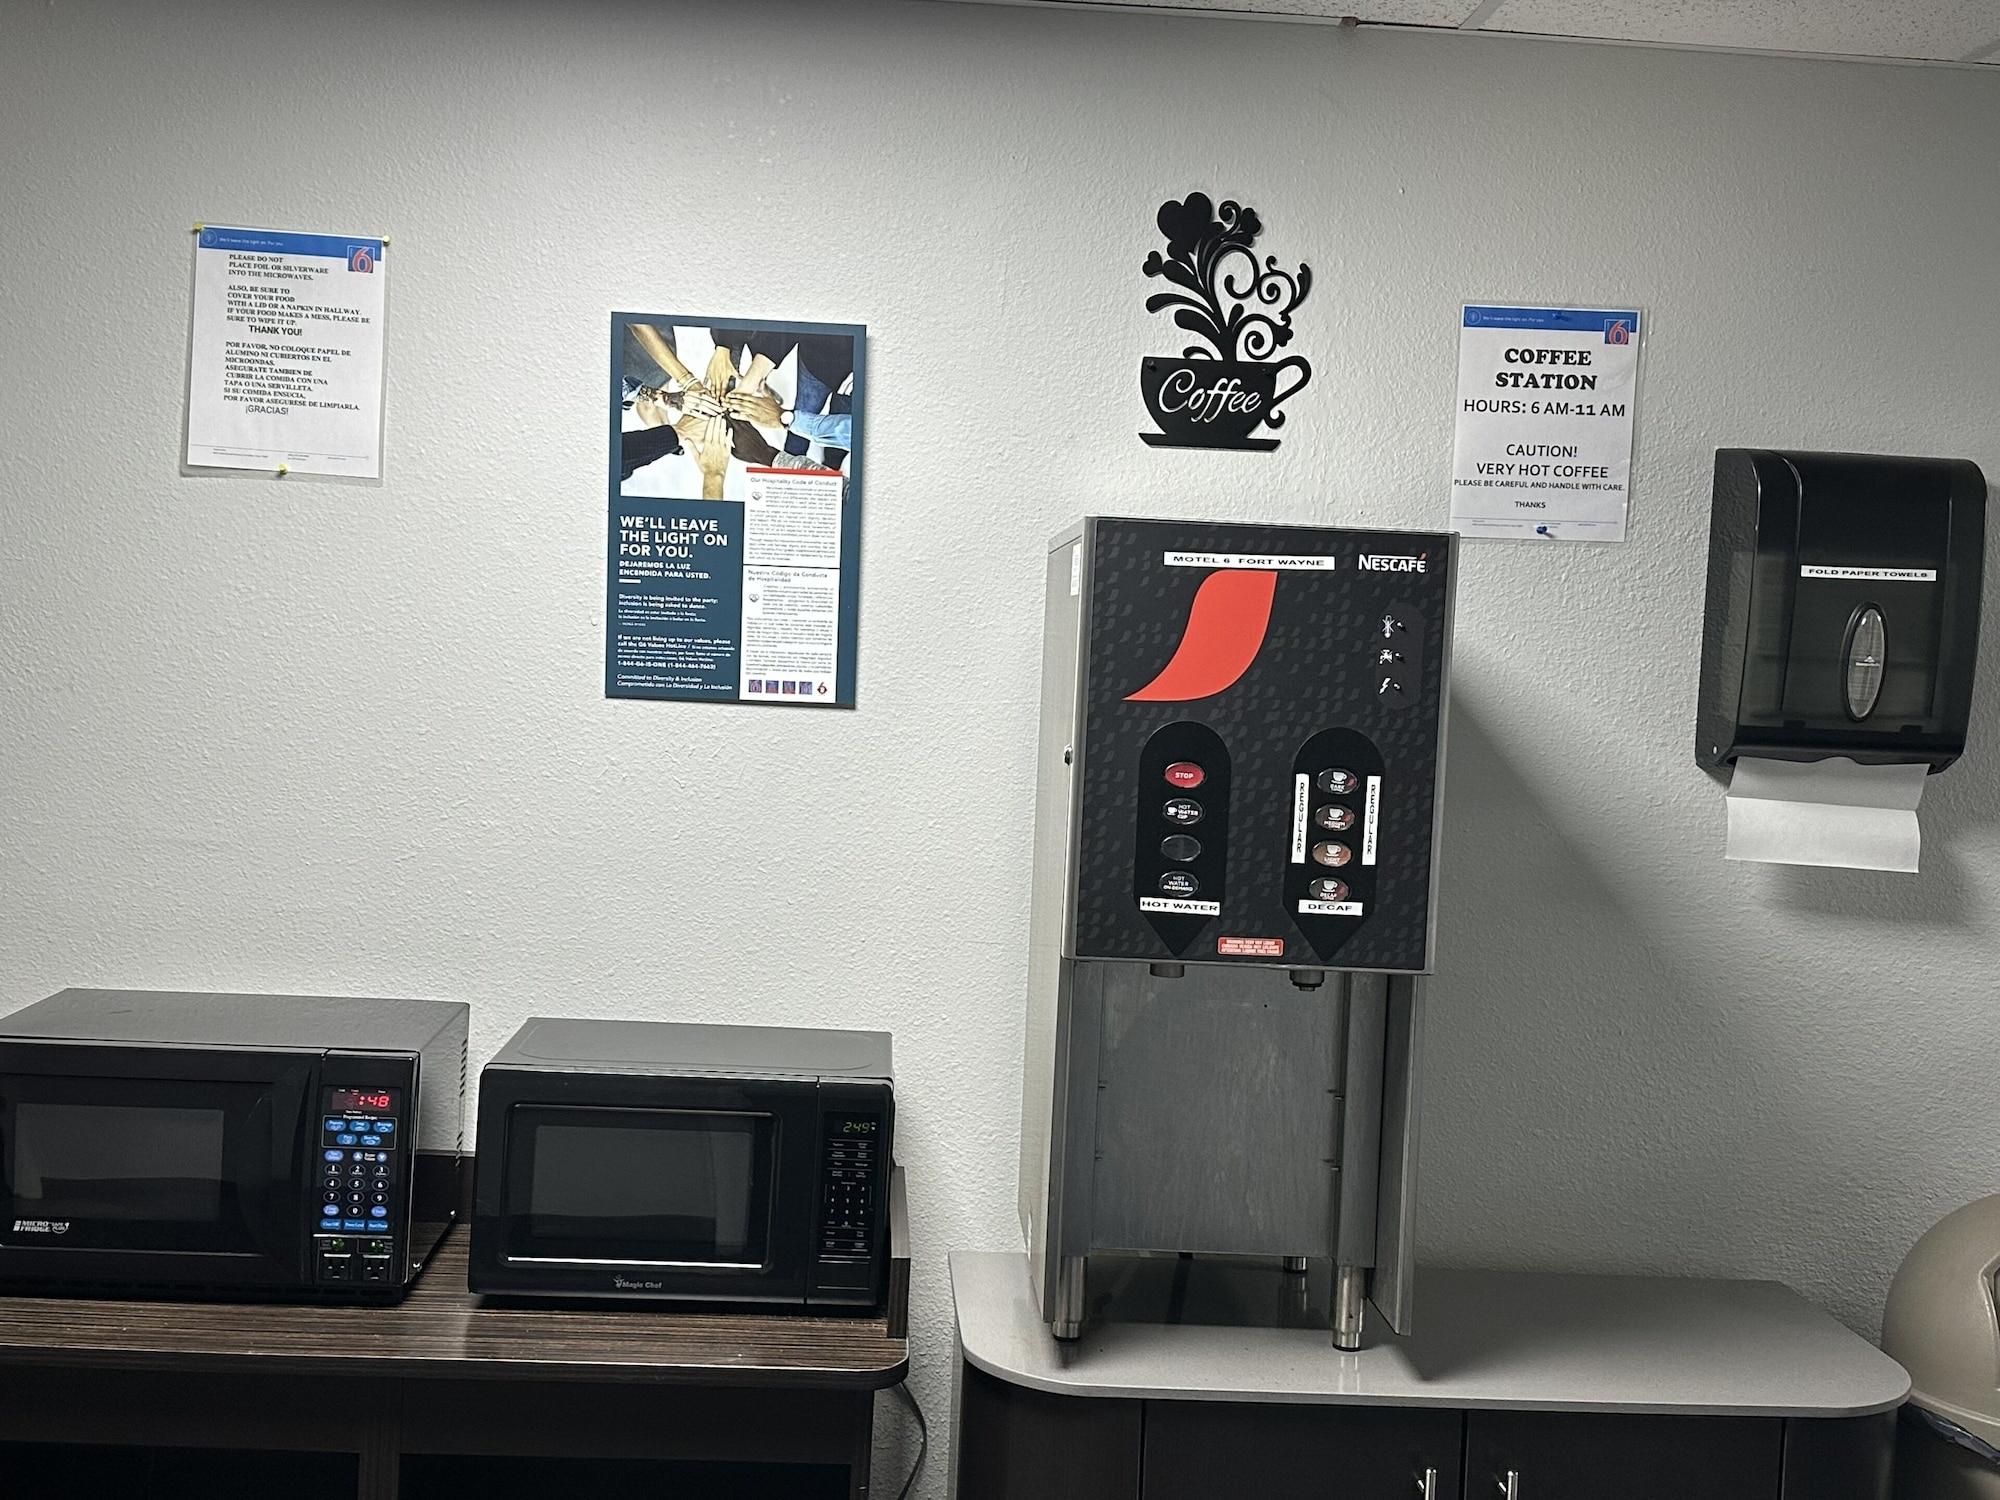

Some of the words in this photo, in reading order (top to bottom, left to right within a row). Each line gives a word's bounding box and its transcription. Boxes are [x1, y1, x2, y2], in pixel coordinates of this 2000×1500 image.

[352, 247, 372, 272] 6
[263, 272, 314, 280] MICROWAVES.
[249, 325, 279, 335] THANK
[281, 327, 302, 336] YOU!
[1608, 320, 1629, 344] 6
[1504, 348, 1592, 366] COFFEE
[268, 383, 313, 391] SERVILLETA.
[1496, 372, 1597, 390] STATION
[1158, 369, 1262, 423] Coffee
[246, 404, 288, 414] ¡GRACIAS!
[1464, 400, 1526, 414] HOURS:
[1531, 402, 1539, 414] 6
[1544, 402, 1596, 416] AM-11
[1600, 404, 1625, 416] AM
[1506, 444, 1577, 457] CAUTION!
[1477, 463, 1515, 475] VERY
[1519, 464, 1550, 476] HOT
[1554, 466, 1608, 478] COFFEE
[620, 516, 665, 529] WE'LL
[671, 518, 718, 531] LEAVE
[620, 530, 649, 543] THE
[655, 532, 699, 546] LIGHT
[704, 533, 728, 547] ON
[620, 544, 650, 556] FOR
[655, 545, 693, 558] YOU.
[1173, 556, 1219, 564] MOTEL
[1358, 553, 1426, 573] NESCAFÉ
[817, 682, 828, 695] 6
[1367, 784, 1376, 855] REGULAR
